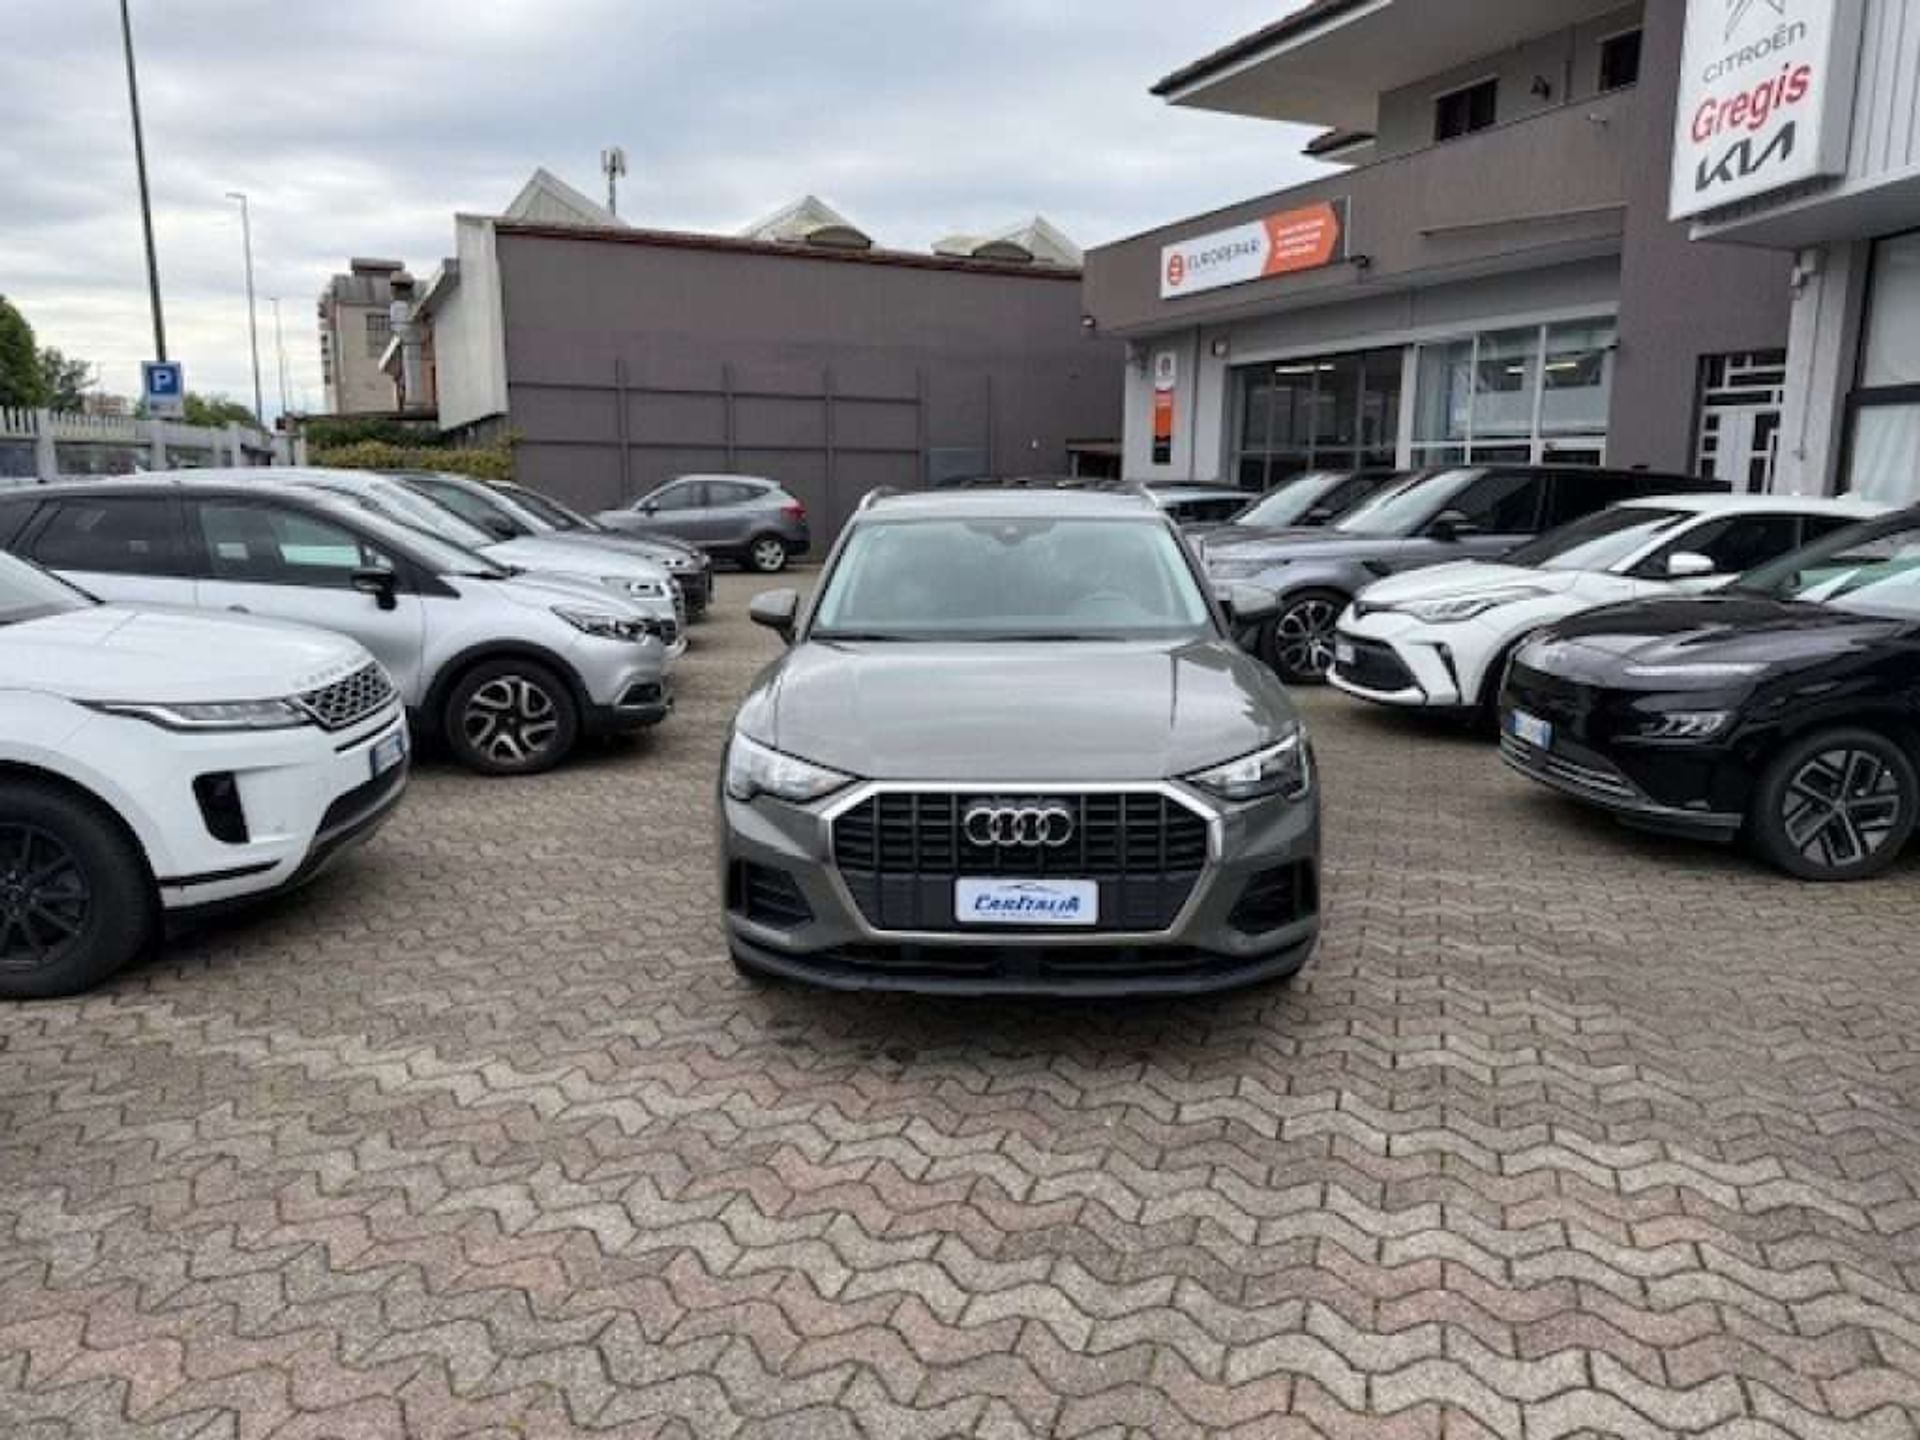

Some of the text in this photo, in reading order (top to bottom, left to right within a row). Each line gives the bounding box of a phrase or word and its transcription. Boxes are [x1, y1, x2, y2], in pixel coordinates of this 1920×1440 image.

[1691, 62, 1811, 143] Gregis
[1695, 120, 1796, 192] KIA
[153, 369, 173, 392] P
